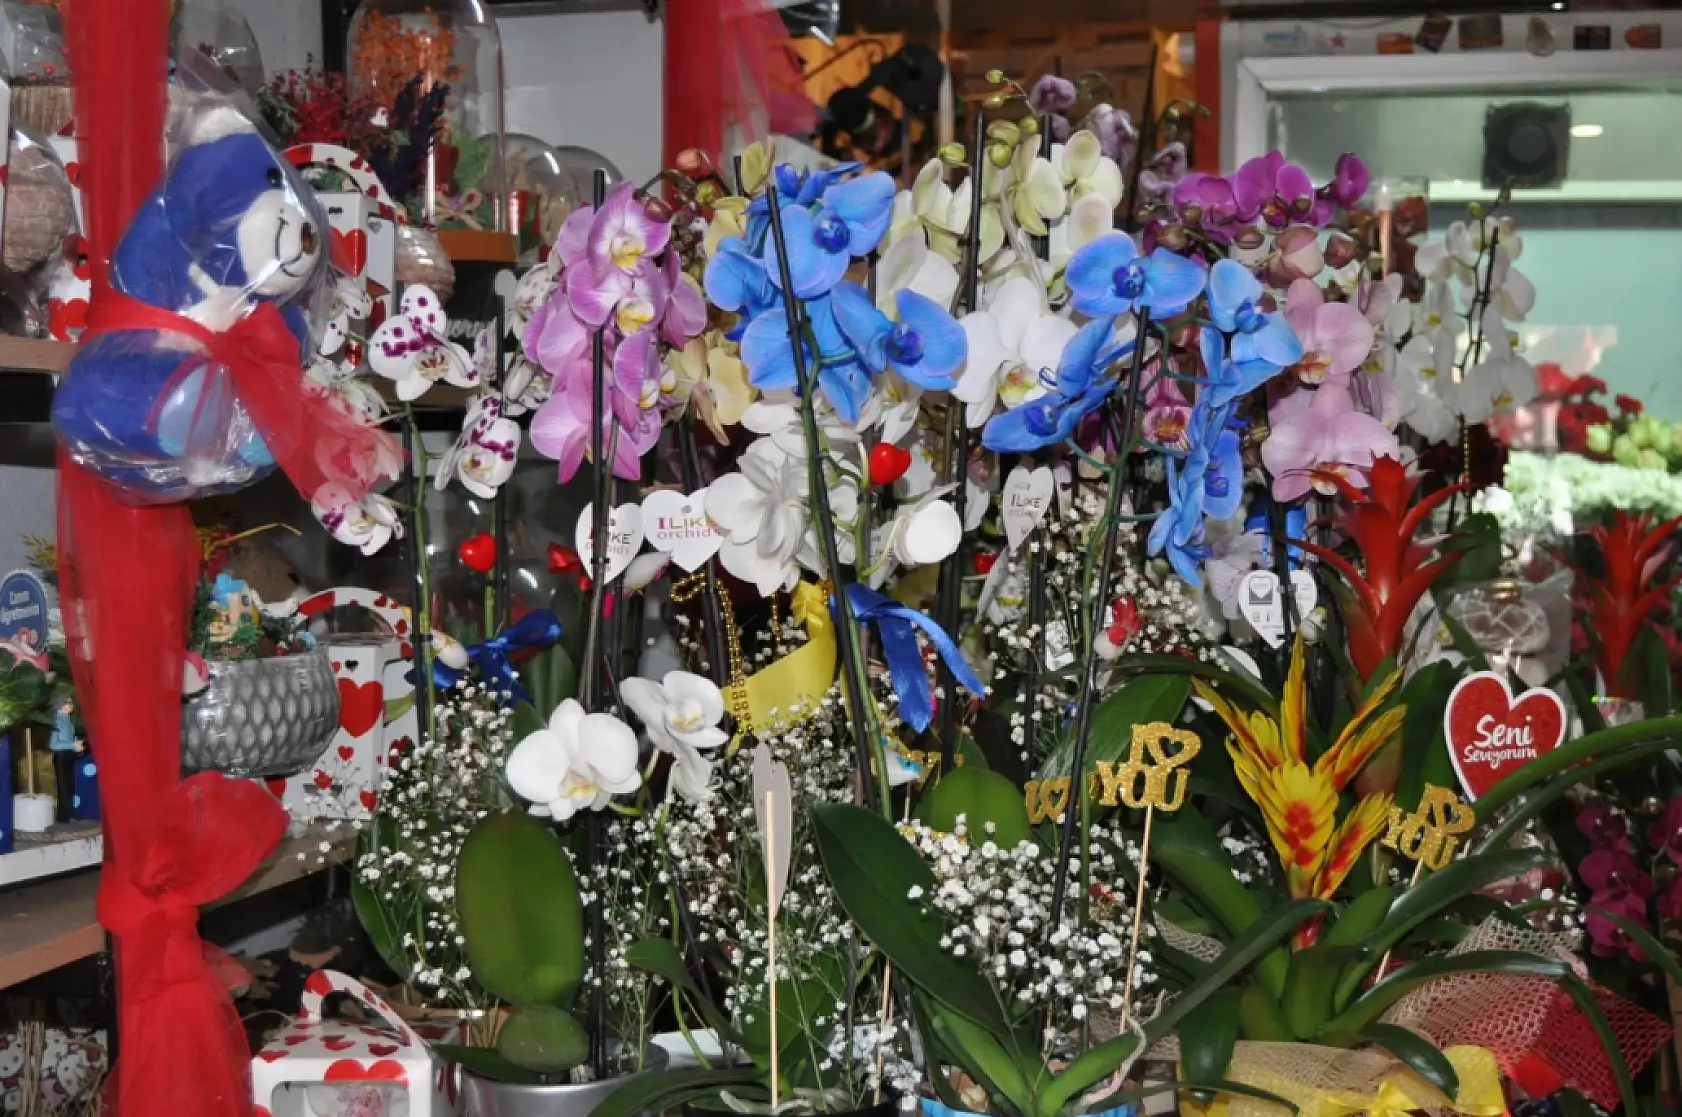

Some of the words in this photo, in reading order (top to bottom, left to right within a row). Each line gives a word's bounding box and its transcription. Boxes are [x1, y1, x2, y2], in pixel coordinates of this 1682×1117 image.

[657, 528, 714, 540] orchid
[1474, 714, 1533, 748] Seni
[1463, 744, 1537, 770] Seviyorum
[1096, 760, 1192, 812] YOU
